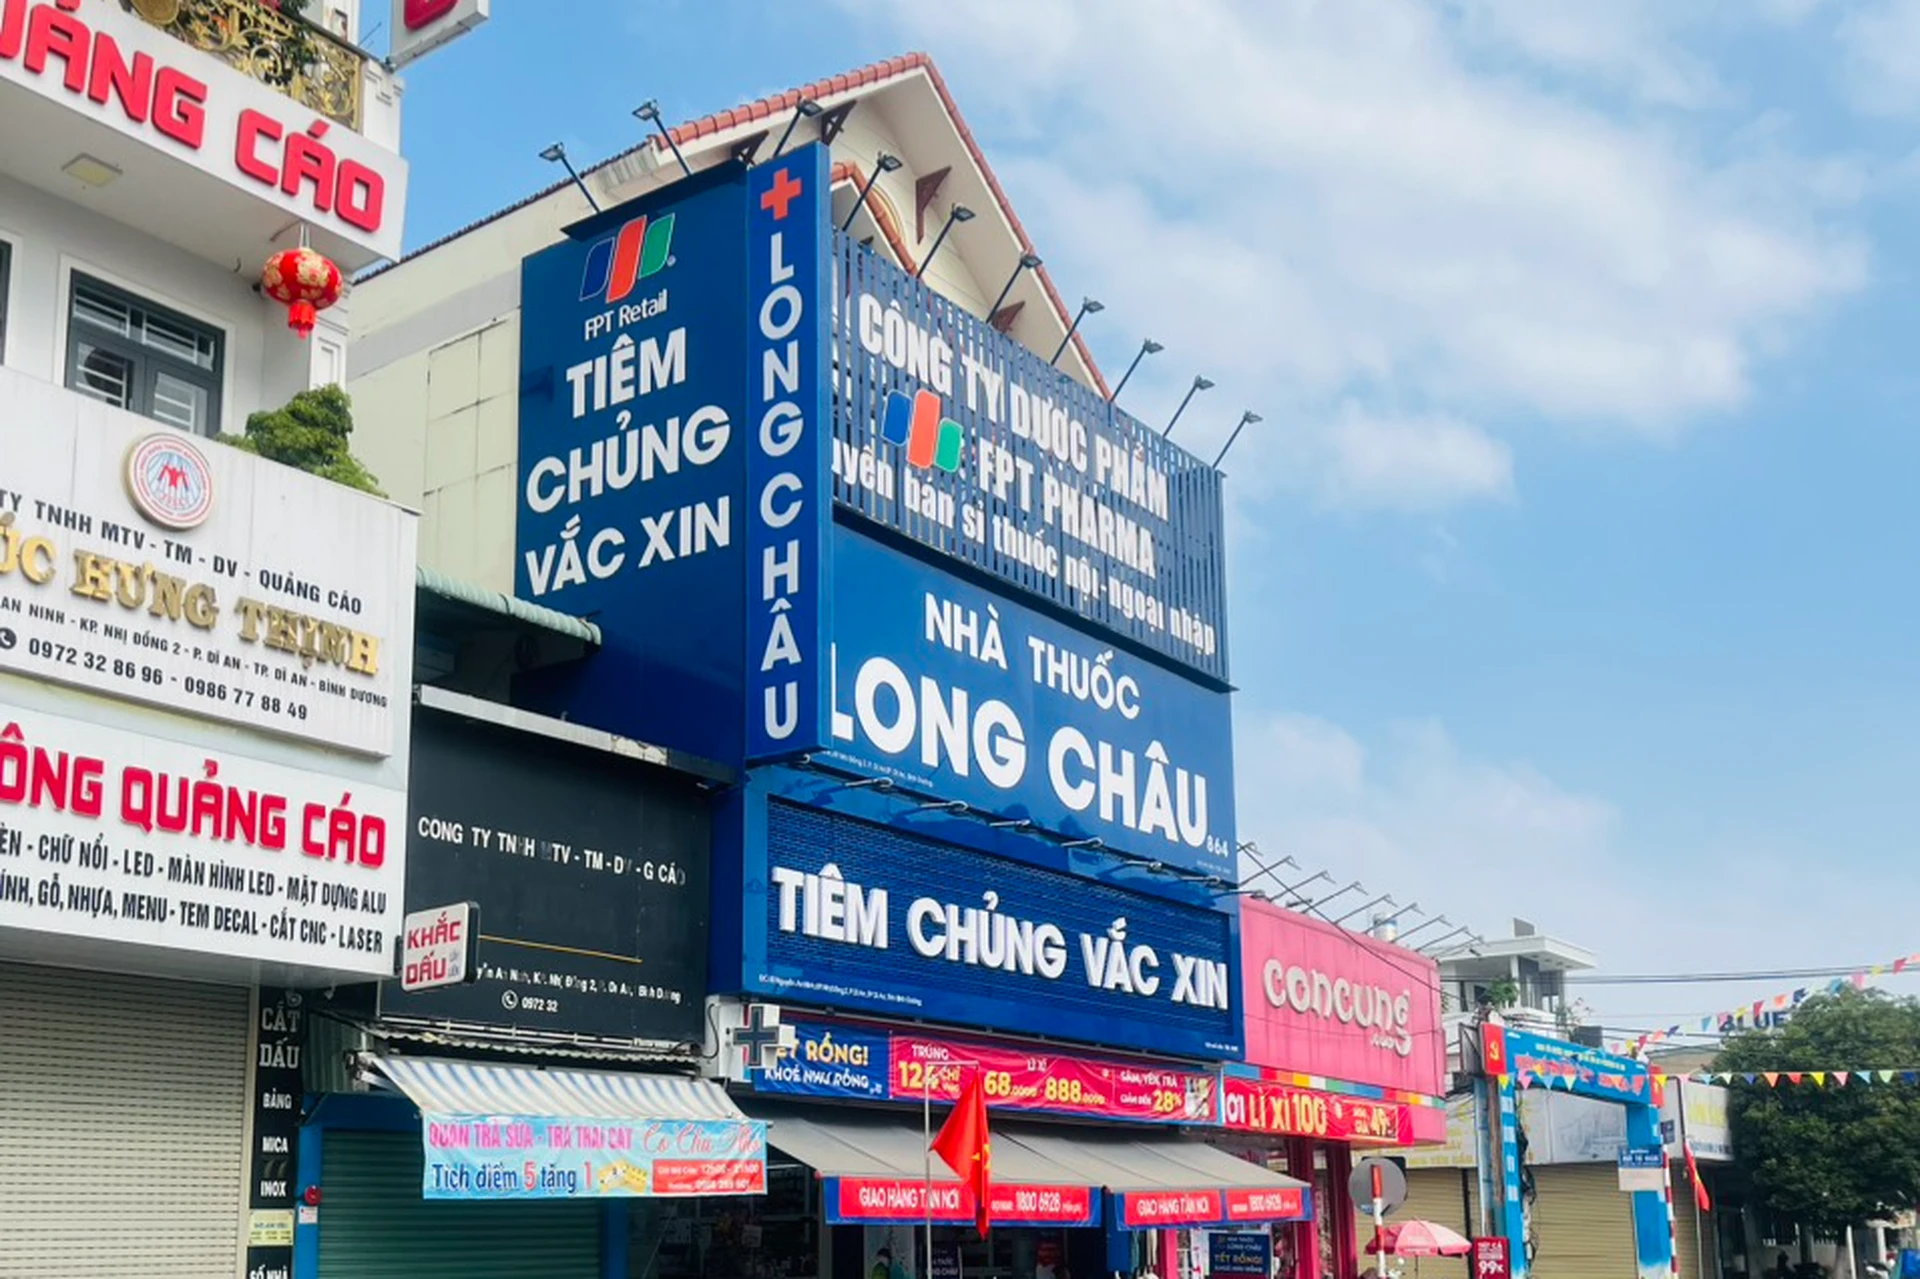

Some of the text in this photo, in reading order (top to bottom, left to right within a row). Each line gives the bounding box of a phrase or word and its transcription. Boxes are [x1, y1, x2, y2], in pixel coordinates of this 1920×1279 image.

[235, 108, 384, 232] CÁO
[585, 288, 667, 341] FPT Retail
[566, 327, 687, 418] TIÊM
[860, 293, 1168, 522] CÔNG TY DƯỢC PHẨM
[526, 403, 731, 513] CHỦNG
[759, 232, 804, 740] LONG CHÂU
[526, 495, 730, 596] VẮC XIN
[978, 439, 1156, 580] FPT PHARMA
[35, 500, 92, 534] TNHH
[101, 521, 145, 549] MTV
[163, 539, 192, 565] TM
[213, 555, 238, 577] DV
[259, 570, 320, 602] QUẢNG
[327, 590, 362, 615] CÁO
[904, 464, 955, 529] bán
[962, 500, 985, 544] sỉ
[993, 513, 1059, 578] thuốc
[1170, 607, 1215, 655] nhập
[1, 596, 21, 613] AN
[29, 604, 65, 625] NINH
[104, 624, 127, 645] NHỊ
[172, 642, 181, 655] 2
[193, 647, 202, 661] P.
[223, 655, 241, 671] AN
[290, 673, 308, 688] AN
[70, 548, 219, 632] HƯNG
[234, 597, 380, 677] THỊNH
[925, 591, 1140, 720] NHÀ THUỐC
[29, 638, 308, 720] 0972 32 86 96 0986 77 88 49
[830, 641, 1208, 848] LONG CHÂU
[120, 759, 287, 851] QUẢNG
[302, 792, 386, 868] CÁO
[471, 827, 491, 848] TY
[584, 850, 603, 870] TM
[37, 872, 64, 911] GỖ,
[67, 884, 117, 918] NHỰA,
[122, 892, 167, 923] MENU
[180, 901, 209, 928] TEM
[214, 907, 258, 935] DECAL
[270, 907, 298, 940] CẮT
[300, 919, 327, 944] CNC
[339, 925, 383, 953] LASER
[38, 834, 74, 863] CHỮ
[79, 832, 109, 870] NỔI
[124, 849, 154, 877] LED
[168, 854, 205, 887] MÀN
[209, 859, 244, 892] HÌNH
[249, 870, 275, 896] LED
[287, 874, 318, 907] MẶT
[322, 882, 358, 911] DỰNG
[361, 889, 387, 914] ALU
[406, 950, 446, 984] DẤU
[408, 911, 461, 949] KHẮC
[772, 862, 1229, 1011] TIÊM CHỦNG VẮC XIN
[546, 999, 559, 1012] 32
[259, 1036, 300, 1069] DẤU
[263, 1087, 292, 1109] BẢNG
[260, 1180, 286, 1197] INOX
[262, 1136, 289, 1153] MICA
[432, 1163, 469, 1189] Tích
[476, 1161, 517, 1190] điểm
[524, 1160, 535, 1190] 5
[584, 1160, 592, 1189] 1
[860, 1186, 886, 1208] GIAO
[887, 1182, 918, 1208] HÀNG
[920, 1188, 940, 1208] TN
